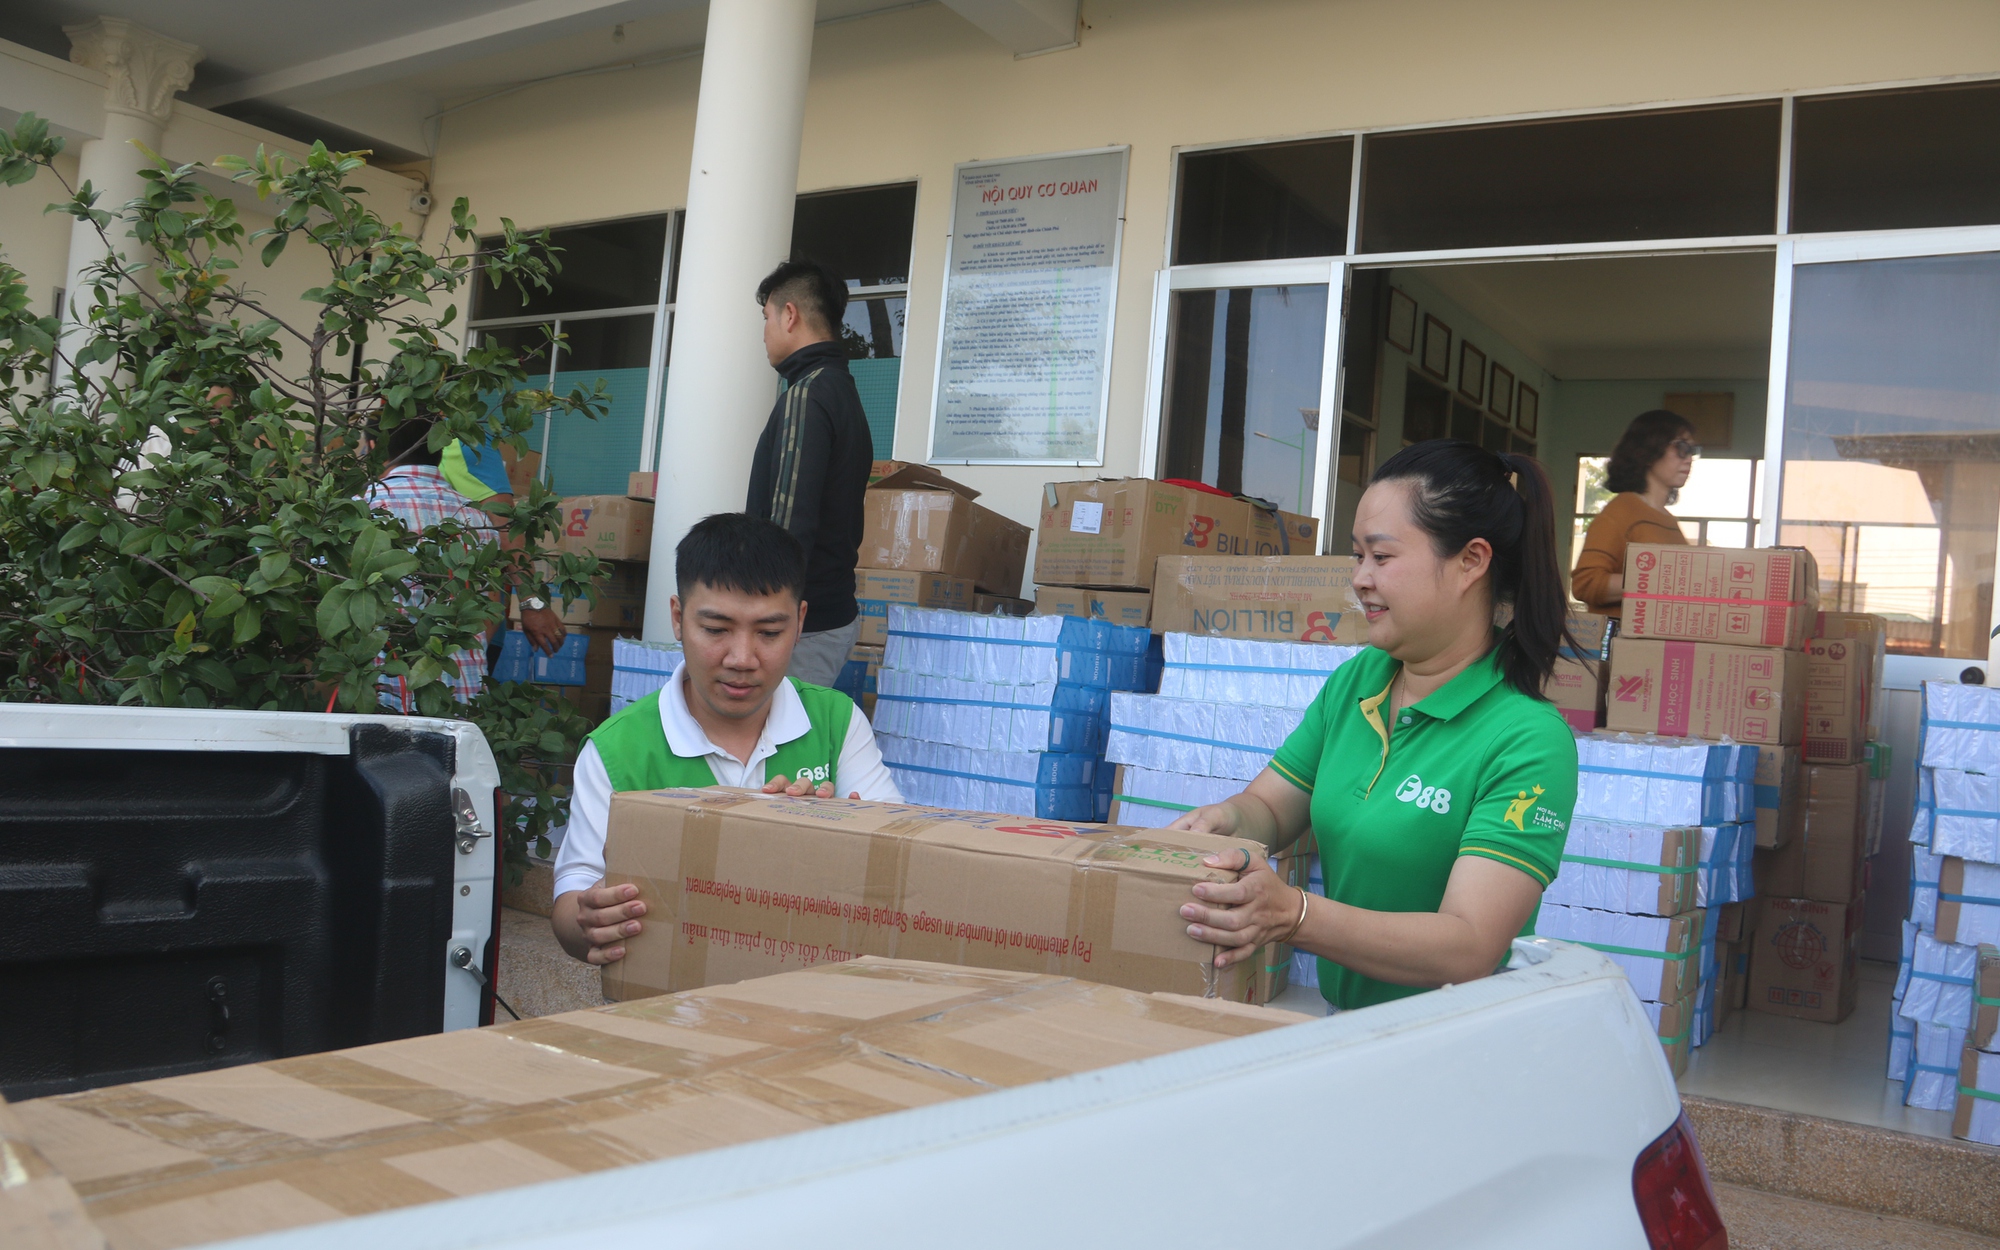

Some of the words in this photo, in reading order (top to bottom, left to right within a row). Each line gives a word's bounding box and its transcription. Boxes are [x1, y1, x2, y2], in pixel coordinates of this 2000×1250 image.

[983, 186, 1004, 206] NỘI
[1009, 185, 1033, 200] QUY
[1038, 182, 1056, 197] CƠ
[1060, 179, 1097, 195] QUAN
[1155, 502, 1177, 516] DTY
[597, 532, 615, 541] DTY
[1638, 555, 1649, 569] 96
[1272, 575, 1303, 587] BILLION
[1304, 576, 1326, 587] TNHH
[870, 603, 884, 614] TẬP
[1632, 601, 1647, 634] MĂNG
[1193, 609, 1294, 633] BILLION
[1830, 645, 1844, 653] 96
[1670, 658, 1680, 681] SINH
[1668, 683, 1678, 705] HỌC
[1665, 708, 1677, 726] TẬP
[1395, 773, 1452, 815] F88
[1535, 813, 1552, 824] LÀM
[1122, 843, 1199, 861] DTY
[685, 876, 741, 905] Replacement
[743, 886, 757, 903] no.
[759, 889, 771, 910] lot
[772, 891, 801, 915] before
[803, 895, 841, 922] required
[843, 903, 852, 923] is
[852, 905, 871, 926] test
[872, 907, 908, 933] Sample
[910, 910, 942, 935] usage.
[681, 922, 707, 945] mẫu
[709, 927, 730, 944] thử
[944, 919, 953, 940] in
[955, 921, 993, 943] number
[994, 928, 1007, 950] lot
[1009, 930, 1023, 946] on
[733, 931, 761, 951] phải
[764, 937, 777, 956] lô
[779, 940, 795, 958] số
[1024, 933, 1069, 957] attention
[1071, 935, 1092, 963] Pay
